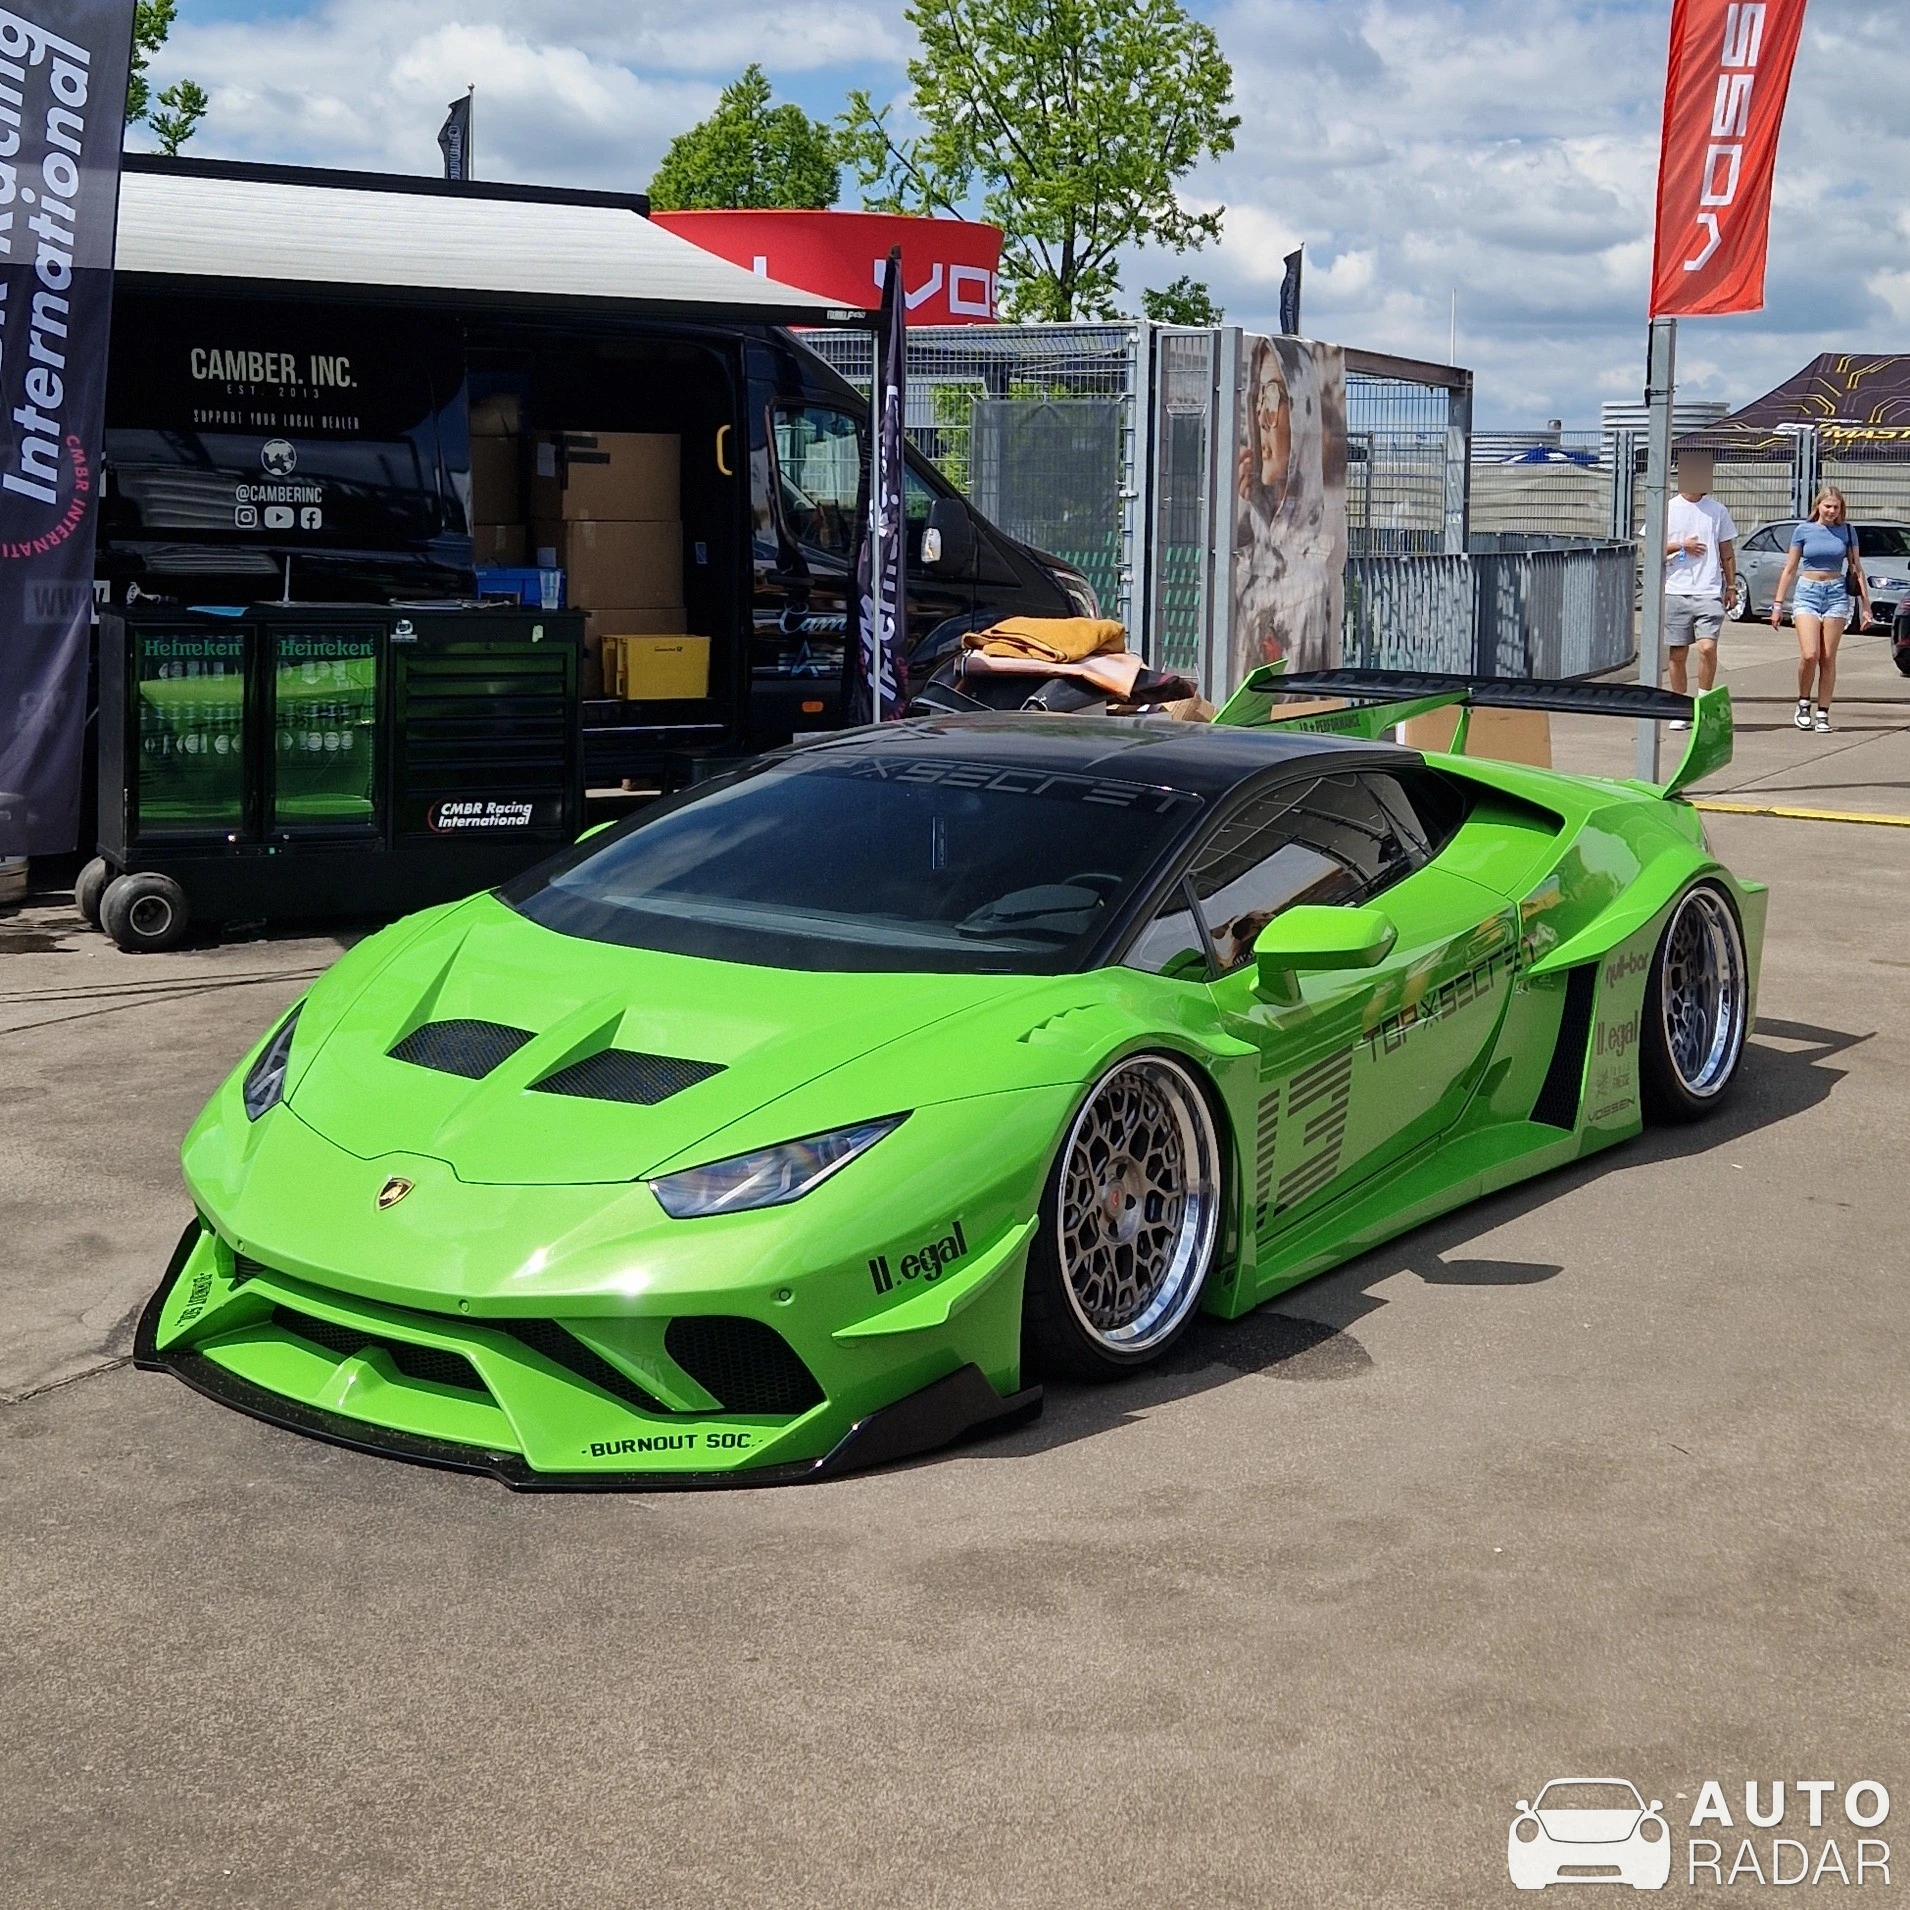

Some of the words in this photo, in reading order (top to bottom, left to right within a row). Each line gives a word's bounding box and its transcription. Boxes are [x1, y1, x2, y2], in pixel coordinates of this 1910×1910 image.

[3, 22, 91, 504] International
[873, 258, 998, 319] VO
[190, 347, 304, 385] CAMBER.
[310, 354, 358, 388] INC.
[226, 383, 265, 396] EST.
[278, 386, 320, 399] 2013
[193, 409, 243, 425] SUPPORT
[250, 412, 276, 426] YOUR
[283, 413, 315, 428] LOCAL
[322, 415, 360, 430] DEALER
[66, 434, 90, 492] CMBR
[235, 484, 323, 503] @CAMBERINC
[143, 638, 244, 656] Heineken
[280, 638, 373, 656] Heineken
[441, 802, 483, 816] CMBR
[485, 800, 533, 816] Racing
[437, 812, 531, 828] International
[589, 1434, 699, 1458] BURNOUT
